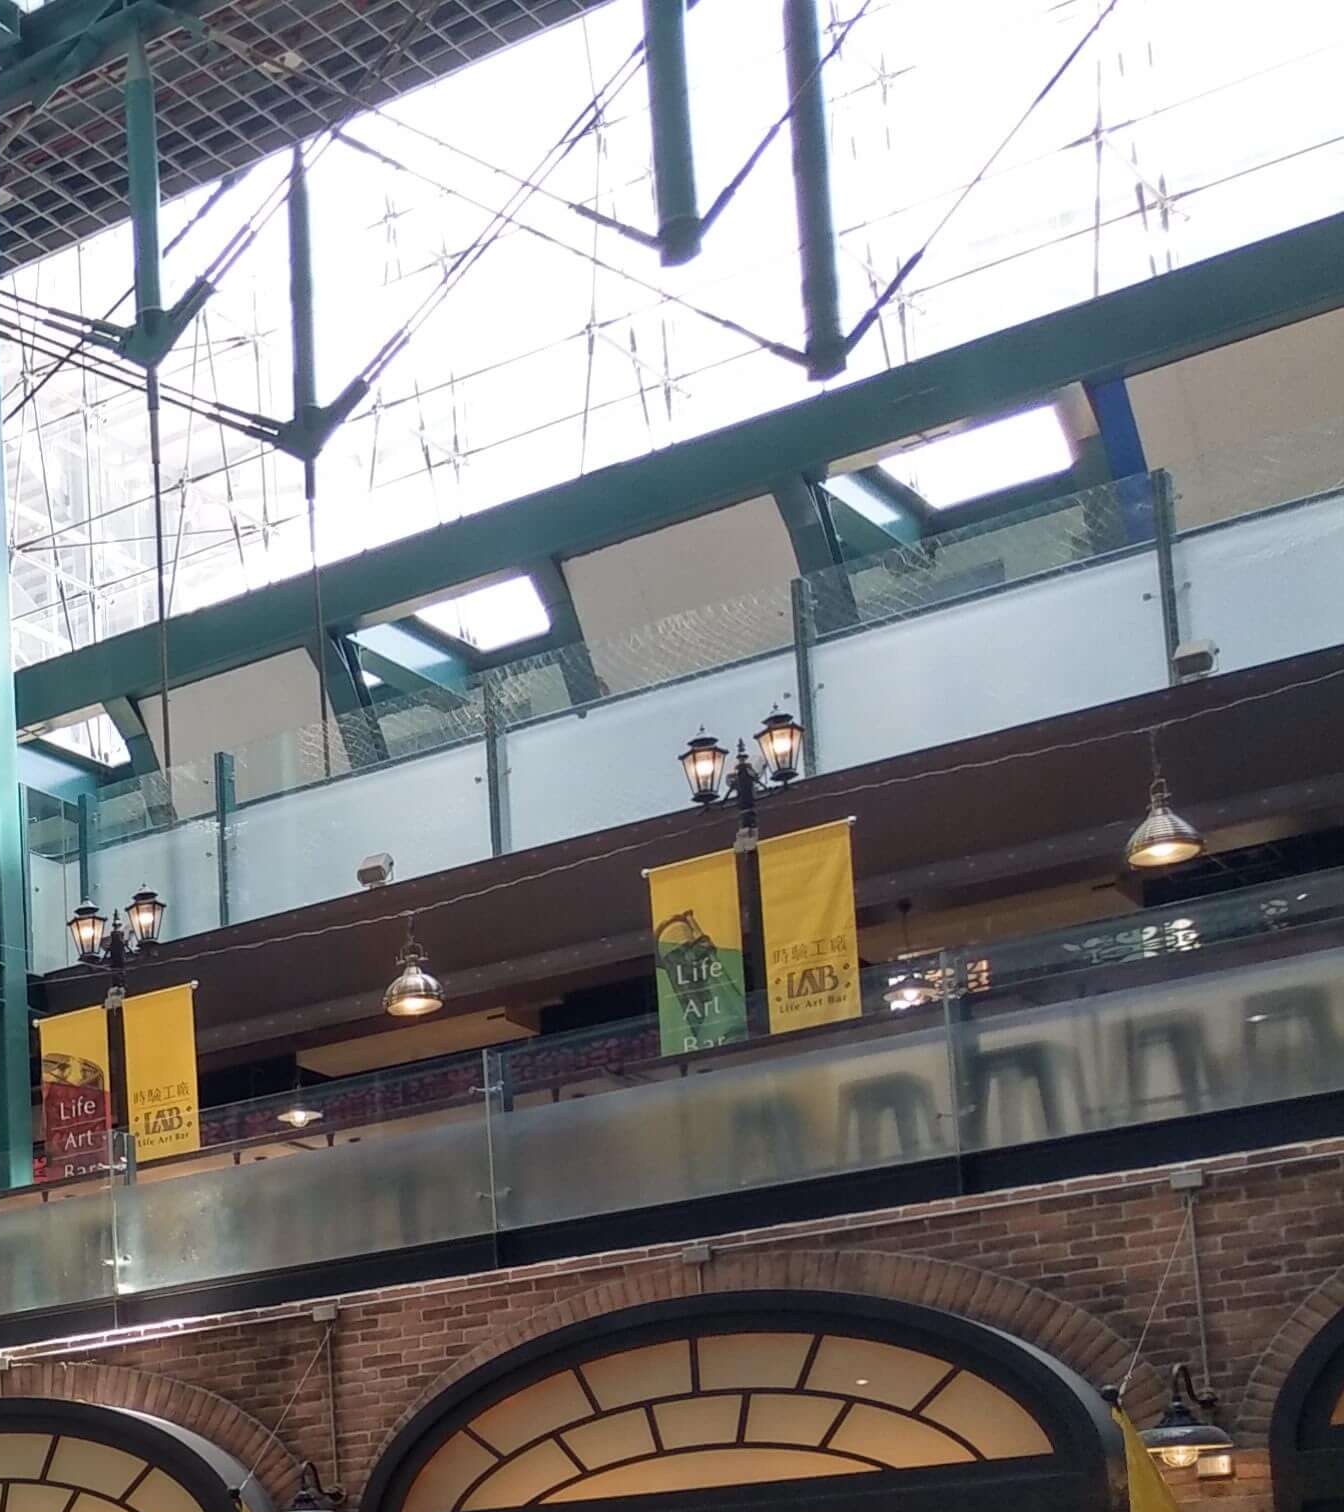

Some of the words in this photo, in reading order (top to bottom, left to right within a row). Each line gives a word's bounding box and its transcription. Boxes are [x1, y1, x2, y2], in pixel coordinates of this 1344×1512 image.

[676, 957, 723, 985] Life
[787, 965, 839, 999] LAB
[683, 995, 721, 1021] Art
[60, 1096, 96, 1120] Life
[144, 1106, 183, 1135] LAB
[64, 1130, 94, 1150] Art
